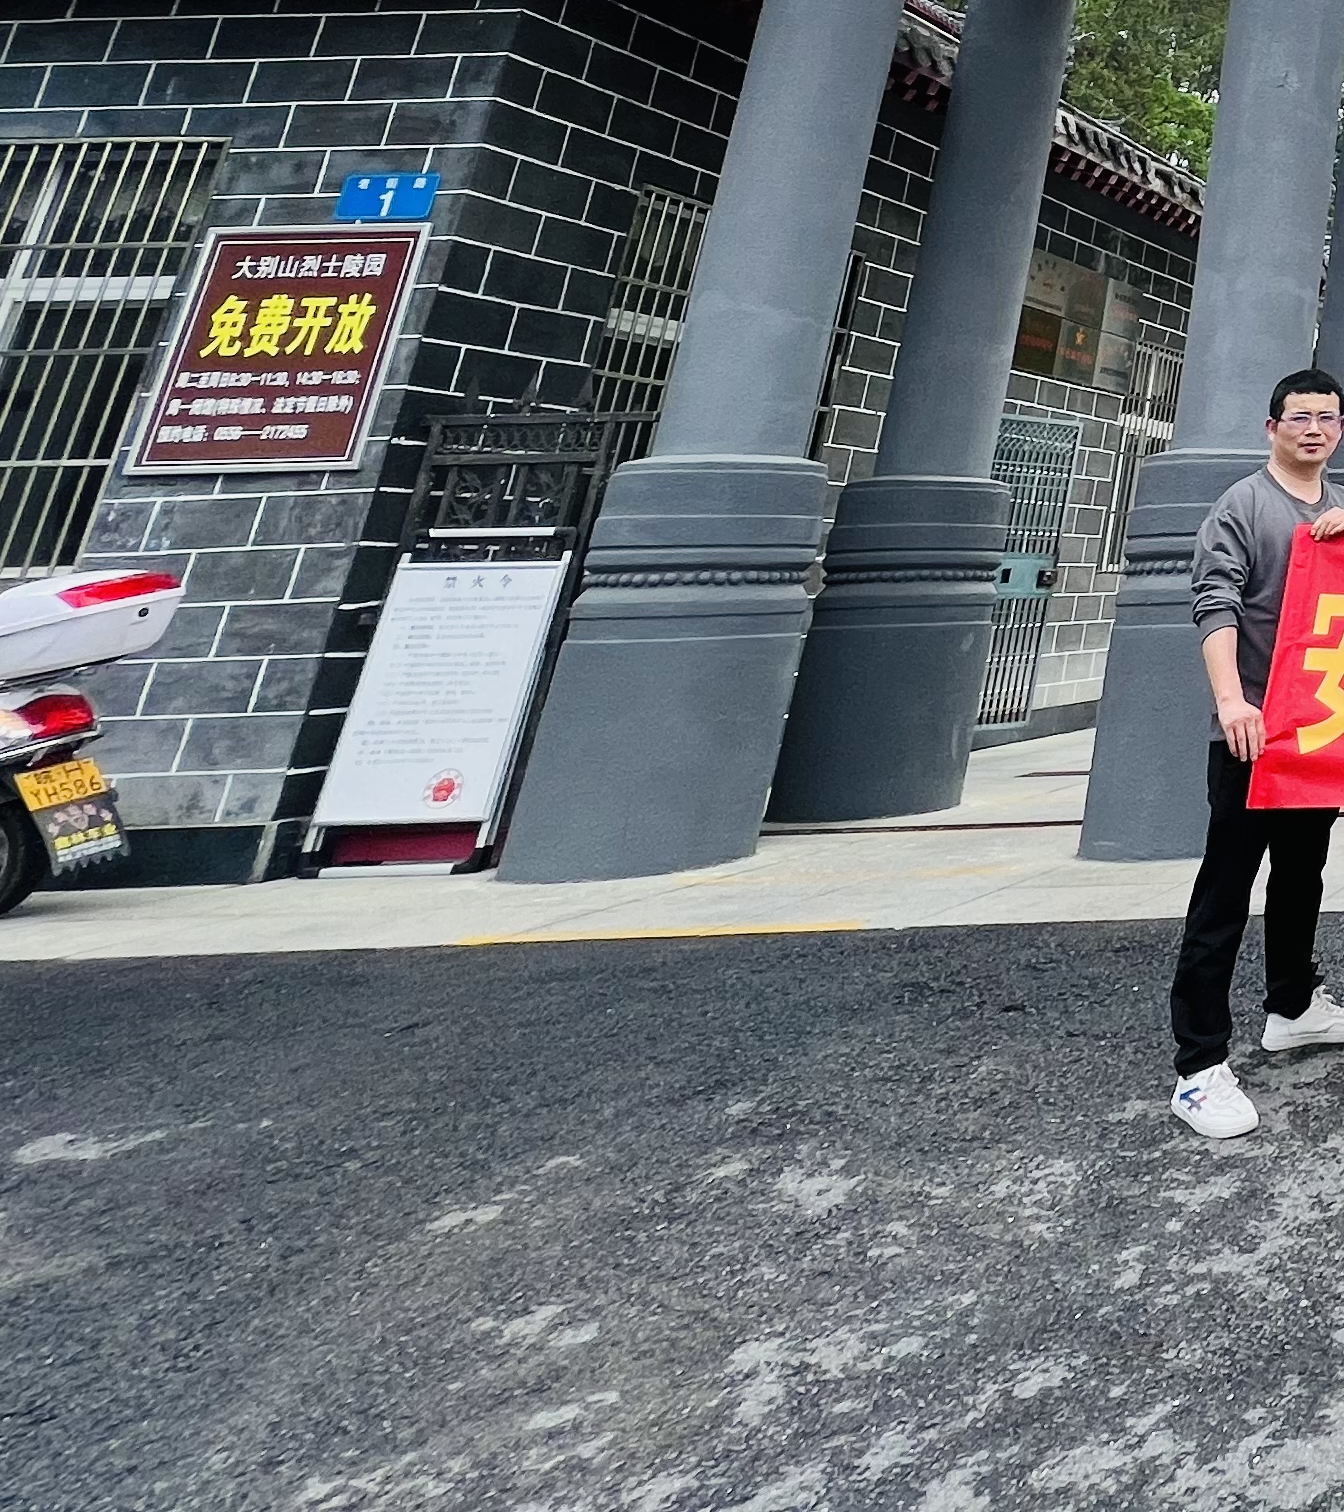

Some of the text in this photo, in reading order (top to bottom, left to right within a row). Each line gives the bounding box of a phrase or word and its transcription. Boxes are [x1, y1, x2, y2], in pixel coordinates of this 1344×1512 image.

[378, 190, 394, 217] 1
[231, 253, 388, 280] 大别山烈士陵园
[200, 292, 377, 358] 免费开放
